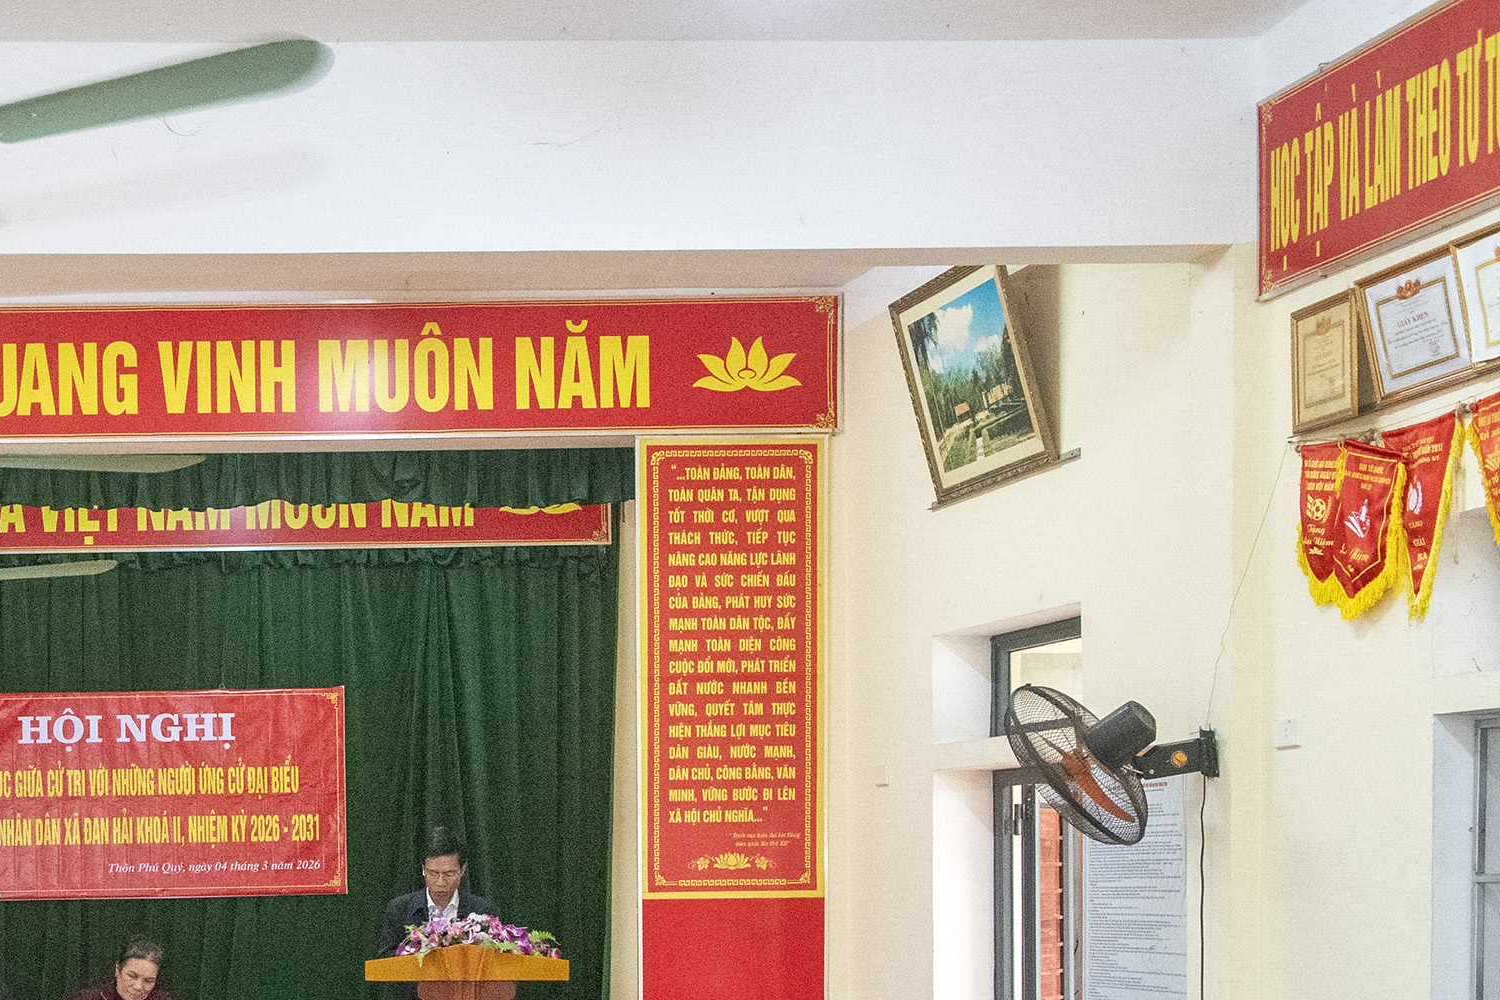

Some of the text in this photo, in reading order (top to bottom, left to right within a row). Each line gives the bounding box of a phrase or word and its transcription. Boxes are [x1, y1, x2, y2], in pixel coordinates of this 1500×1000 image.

[1271, 137, 1300, 271] HỌC
[1305, 102, 1334, 257] TẬP
[1339, 84, 1360, 220] VÀ
[1364, 70, 1400, 210] LÀM
[1406, 58, 1451, 190] THEO
[1456, 29, 1482, 168] TƯ
[159, 341, 296, 413] VINH
[318, 324, 493, 412] MUÔN
[516, 321, 649, 409] NĂM
[713, 464, 742, 480] ĐẢNG,
[745, 465, 770, 479] TOÀN
[773, 464, 795, 480] DÂN,
[668, 486, 796, 503] TOÀN QUÂN TA, TẬN DỤNG
[668, 507, 796, 524] TỐT THỜI CƠ, VƯỢT QUA
[668, 528, 795, 546] THÁCH THỨC, TIẾP TỤC
[18, 708, 235, 752] HỘI NGHỊ
[669, 744, 795, 760] DÂN GIÀU, NƯỚC MẠNH,
[15, 765, 44, 797] GIỮA
[47, 760, 64, 797] CỬ
[67, 770, 85, 796] TRI
[89, 763, 109, 796] VỚI
[112, 764, 155, 796] NHỮNG
[158, 761, 195, 795] NGƯỜI
[199, 762, 224, 794] ỨNG
[228, 757, 245, 794] CỬ
[247, 767, 268, 799] ĐẠI
[271, 754, 298, 793] BIỂU
[669, 763, 796, 781] DÂN CHỦ, CÔNG BẰNG, VĂN
[669, 786, 795, 802] MINH, VỮNG BƯỚC ĐI LÊN
[669, 808, 682, 823] XÃ
[684, 808, 700, 825] HỘI
[703, 806, 722, 823] CHỦ
[35, 813, 60, 846] DÂN
[64, 812, 80, 845] XÃ
[84, 817, 109, 845] ĐAN
[112, 808, 132, 844] HẢI
[136, 811, 169, 844] KHOÁ
[173, 816, 184, 846] II,
[188, 810, 228, 848] NHIỆM
[232, 809, 247, 842] KỲ
[251, 815, 280, 842] 2026
[292, 814, 319, 841] 2031
[109, 860, 320, 874] Thôn Phú Quý, ngày 04 tháng 3 năm 2026
